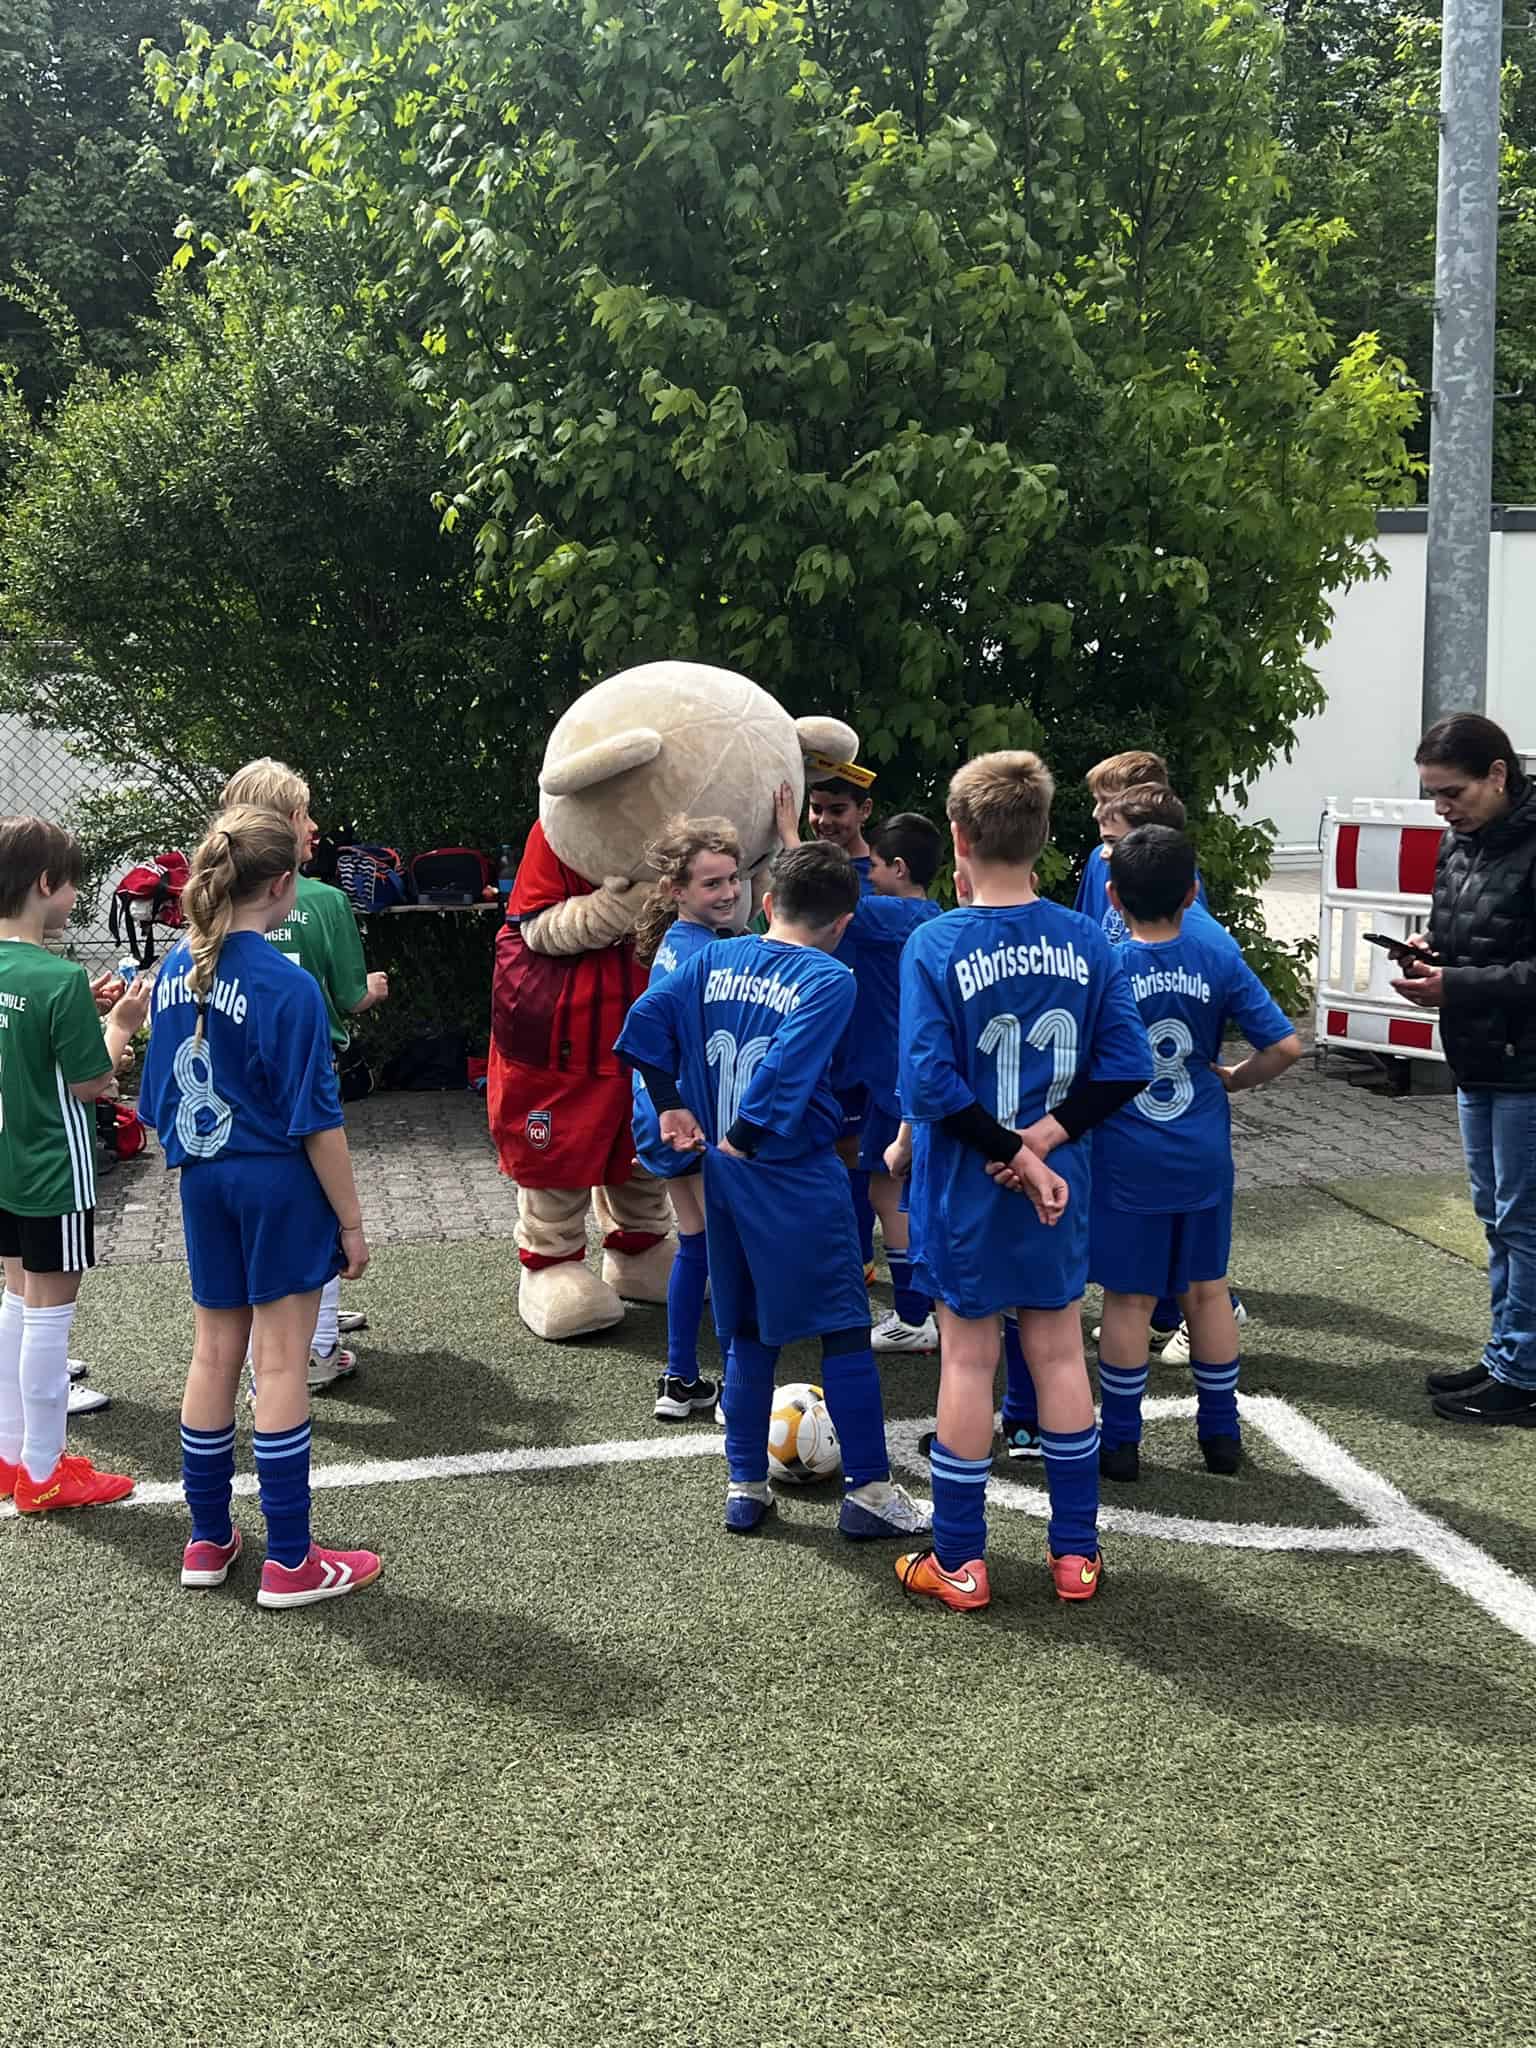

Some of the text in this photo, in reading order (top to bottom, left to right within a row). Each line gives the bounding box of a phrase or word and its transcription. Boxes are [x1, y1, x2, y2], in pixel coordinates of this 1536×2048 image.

[954, 935, 1089, 1002] Bibrisschule
[1130, 965, 1211, 1004] ibrisschule
[173, 1034, 234, 1158] 8
[976, 1008, 1079, 1132] 11
[1133, 1017, 1195, 1122] 8
[530, 1127, 546, 1140] FCH
